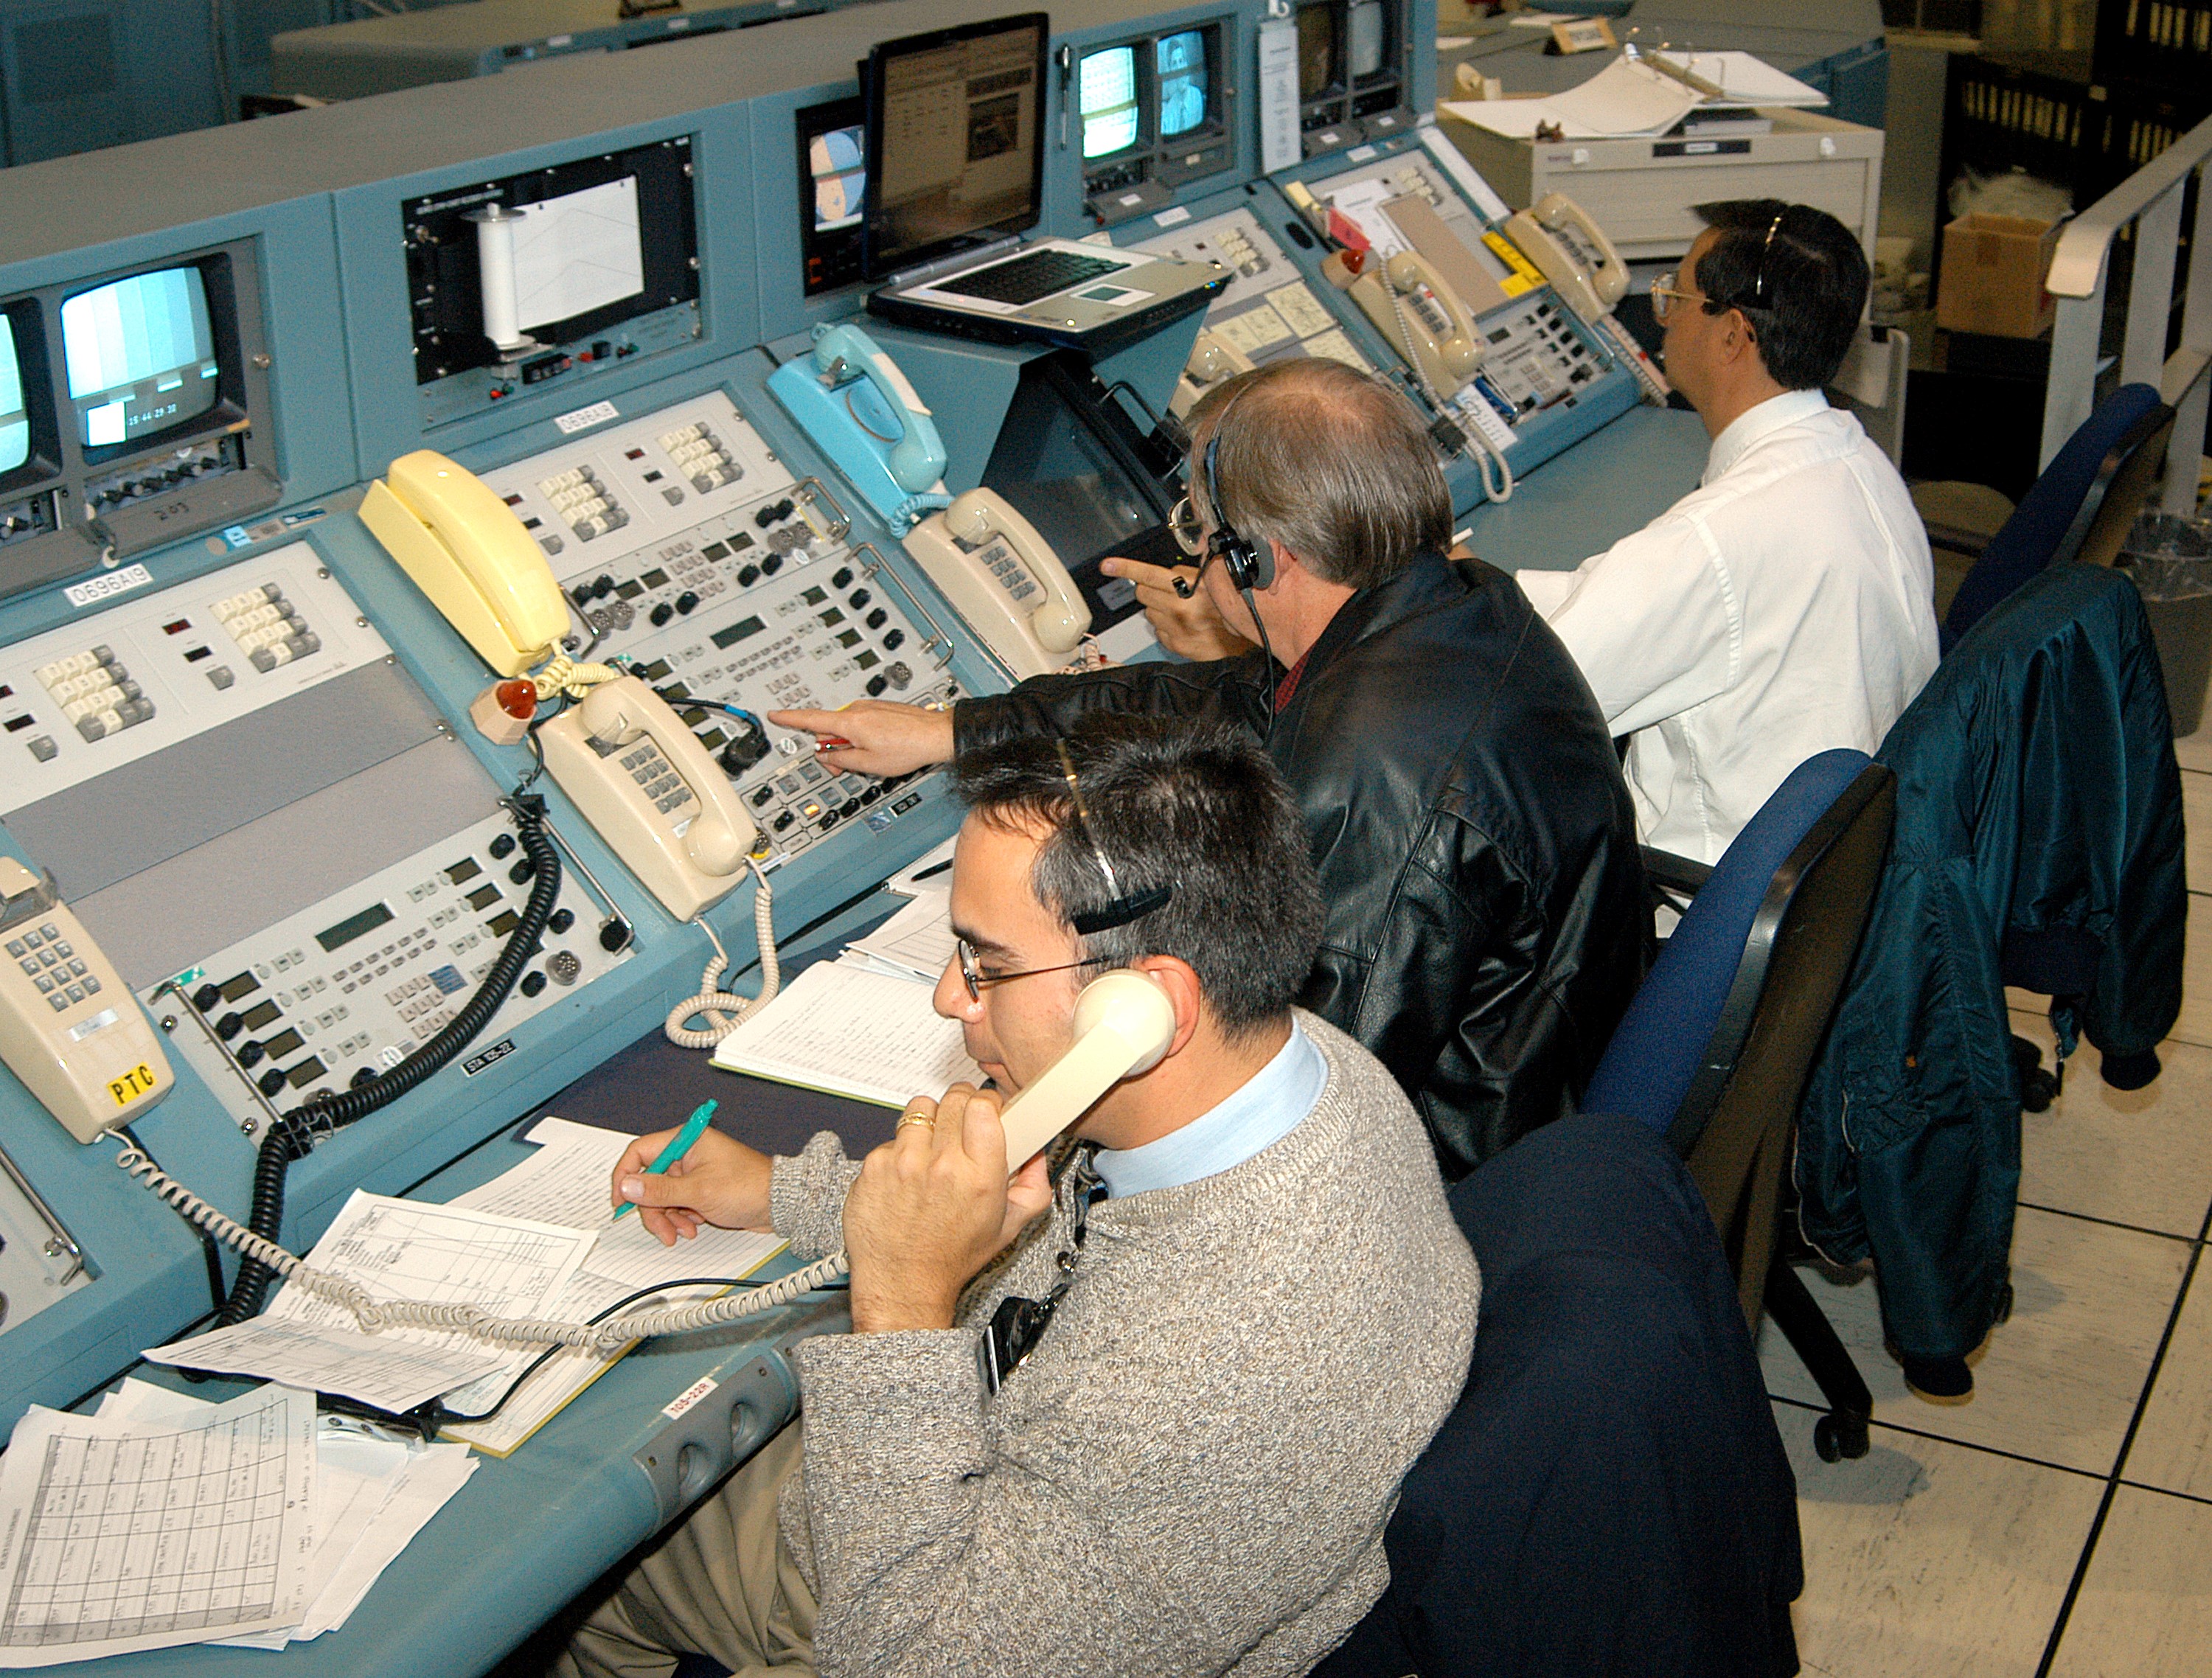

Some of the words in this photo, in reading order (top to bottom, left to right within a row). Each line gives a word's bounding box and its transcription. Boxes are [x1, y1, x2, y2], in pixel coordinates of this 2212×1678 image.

[73, 567, 147, 602] 0696A19
[111, 1065, 154, 1104] PTC
[669, 1382, 711, 1413] 105-22R
